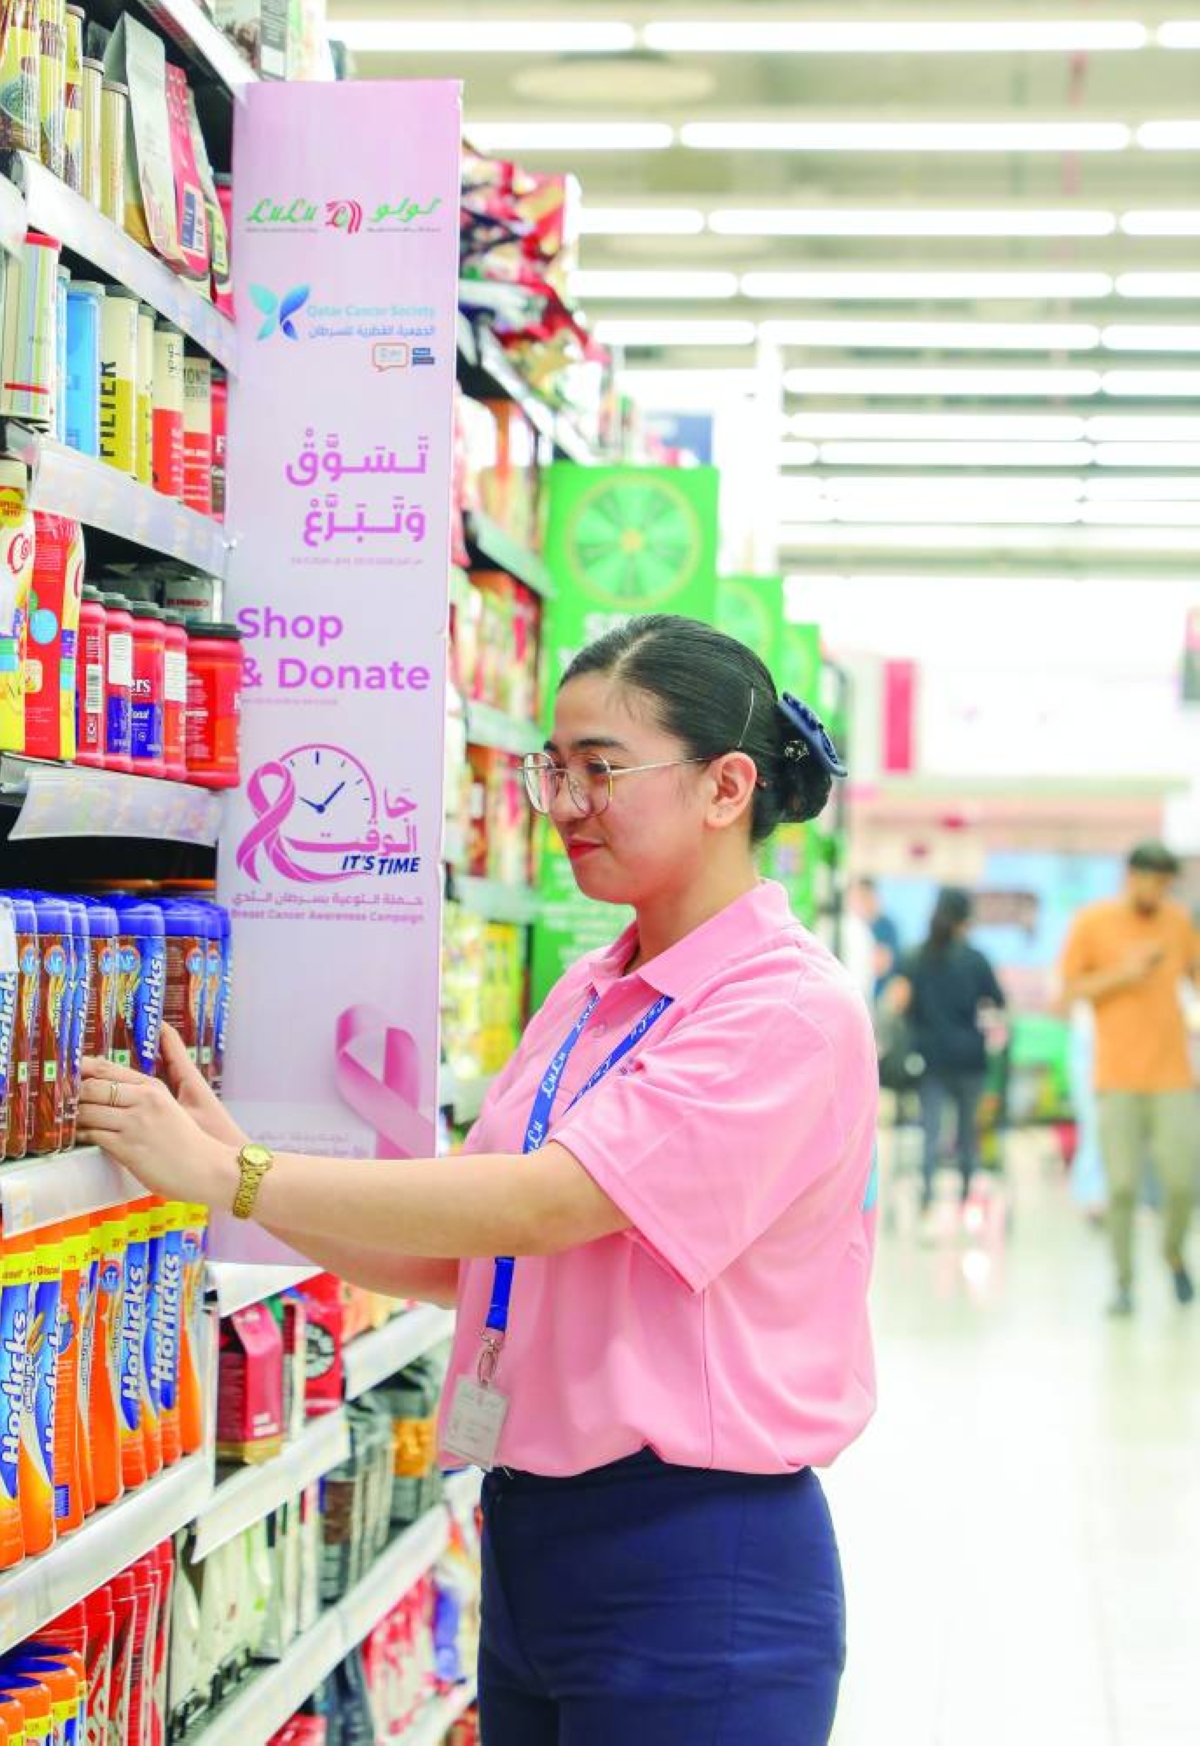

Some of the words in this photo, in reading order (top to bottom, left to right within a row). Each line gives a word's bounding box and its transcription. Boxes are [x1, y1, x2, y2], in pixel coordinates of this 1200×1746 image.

[246, 197, 318, 223] LuLu
[369, 196, 441, 223] لولو
[307, 305, 341, 318] Qatar
[346, 305, 386, 318] Cancer
[391, 305, 435, 319] Society
[237, 606, 343, 647] Shop
[242, 657, 262, 687] &
[278, 658, 431, 690] Donate
[342, 855, 376, 871] IT'S
[378, 857, 421, 875] TIME
[232, 909, 265, 920] Breast
[269, 910, 306, 920] Cancer
[309, 911, 366, 921] Awareness
[370, 911, 424, 924] Campaign
[142, 956, 162, 1060] Horlicks
[541, 1052, 566, 1099] LuLu
[121, 1265, 144, 1400] Horlicks
[161, 1253, 181, 1382] Horlicks
[1, 1310, 28, 1464] Horlicks
